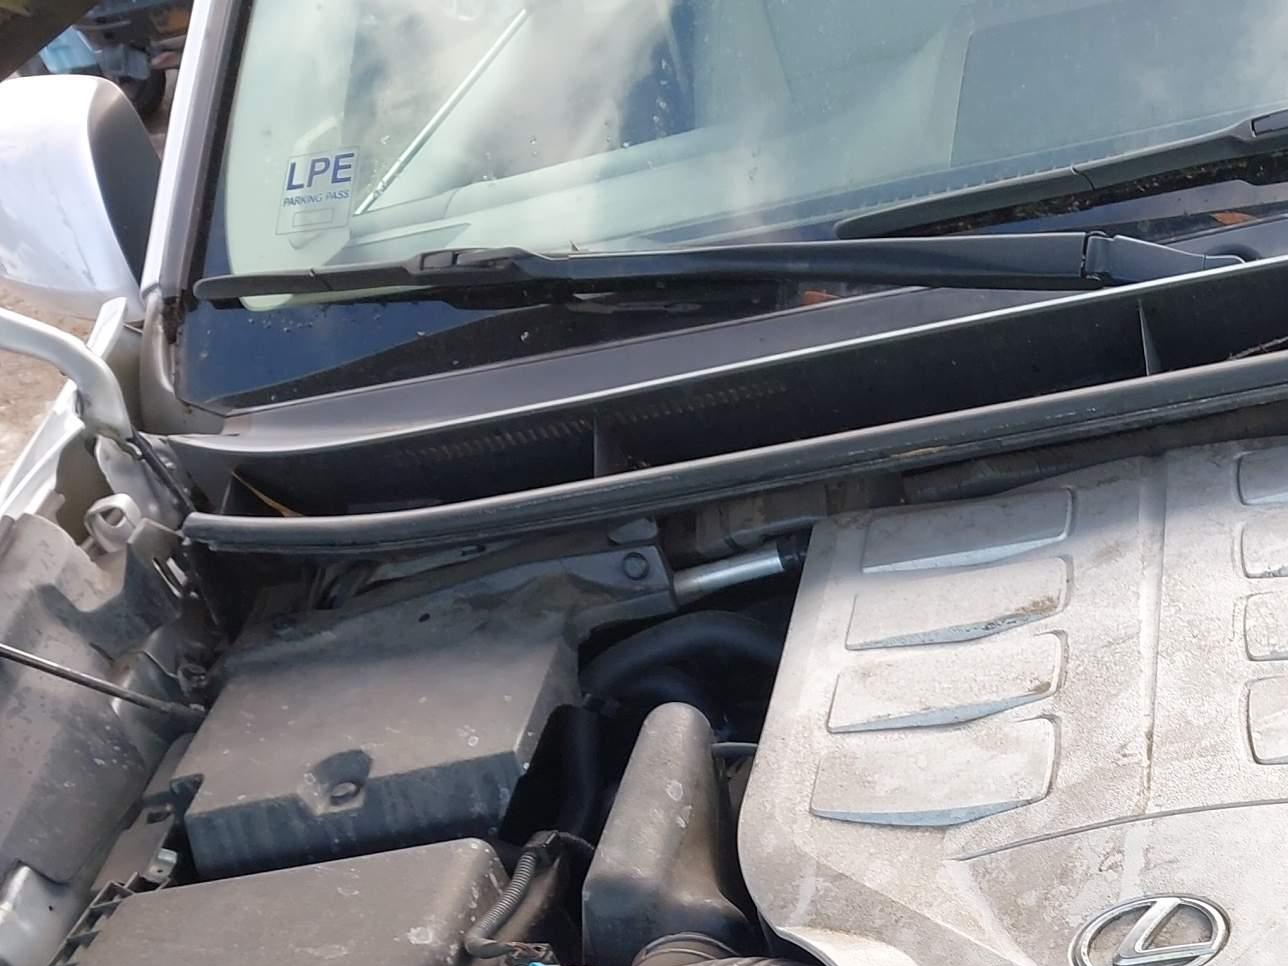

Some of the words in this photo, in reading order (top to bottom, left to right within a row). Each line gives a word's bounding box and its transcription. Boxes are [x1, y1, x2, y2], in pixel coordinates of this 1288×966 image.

[286, 152, 354, 191] LPE
[283, 193, 323, 208] PARKING
[326, 189, 350, 201] PASS
